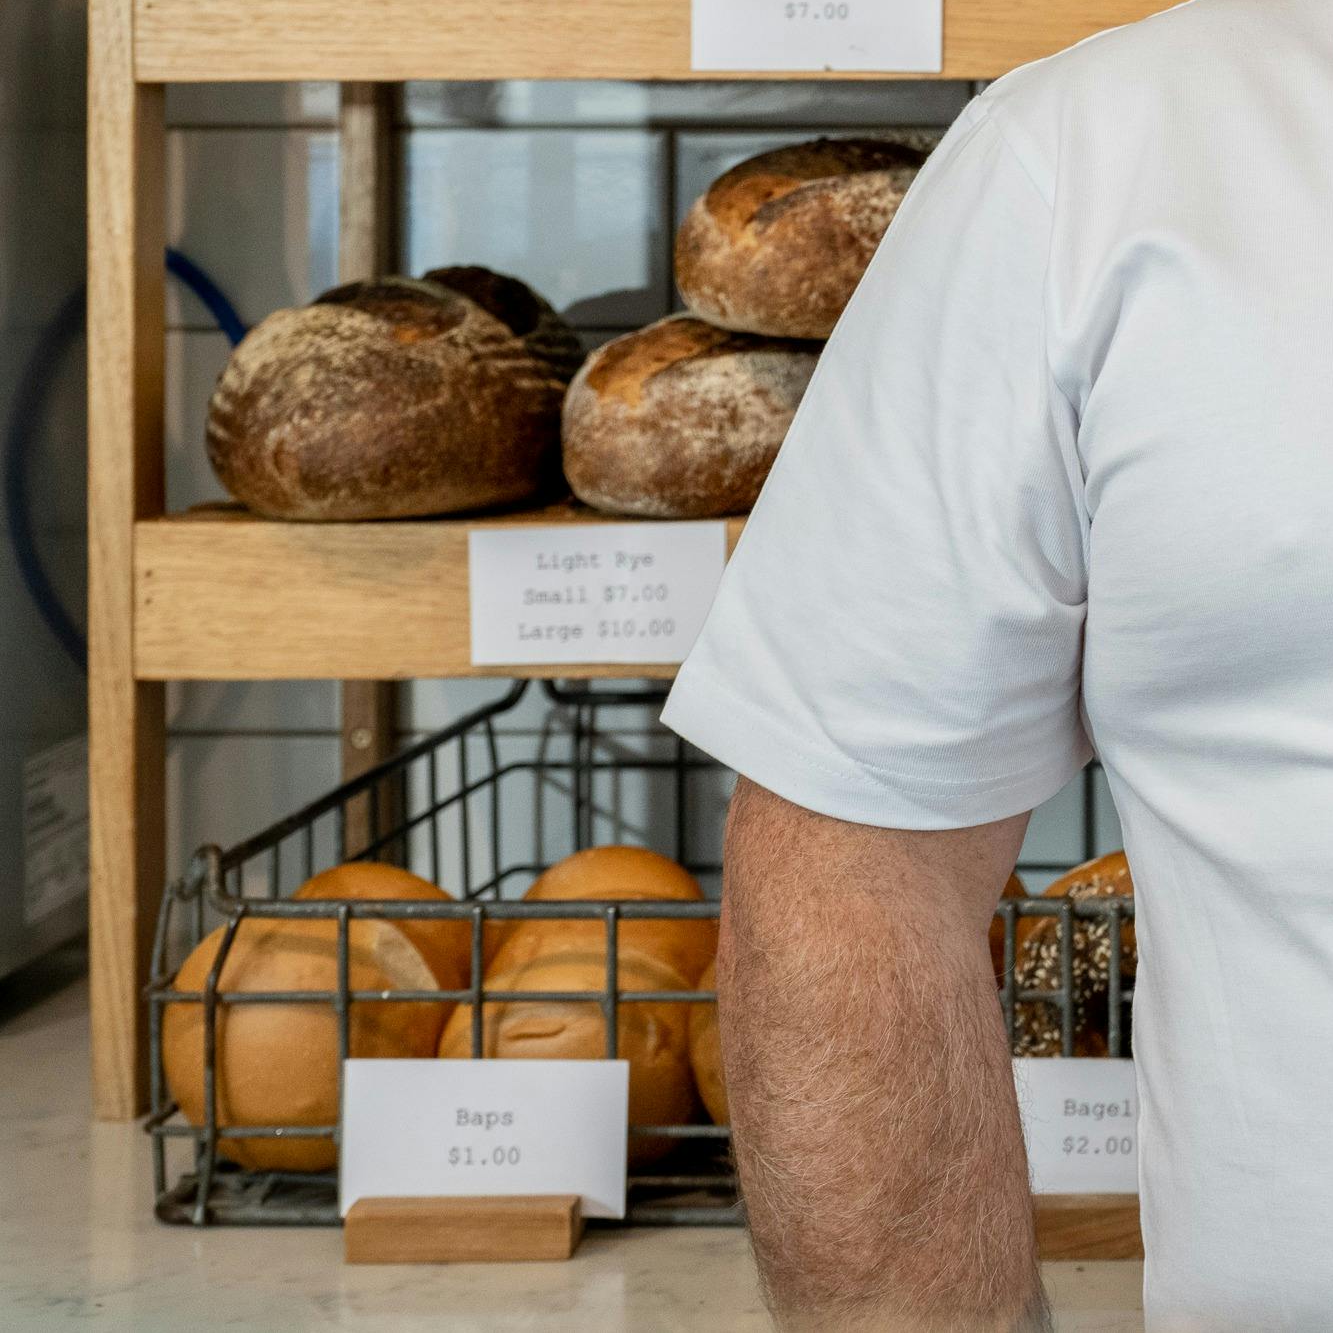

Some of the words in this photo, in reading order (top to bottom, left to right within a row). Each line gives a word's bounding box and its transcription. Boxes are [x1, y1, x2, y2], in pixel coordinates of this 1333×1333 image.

[785, 2, 850, 21] $7.00
[535, 552, 600, 574] Light
[615, 551, 654, 570] Rye
[522, 586, 588, 605] Small
[603, 585, 669, 603] $7.00
[517, 622, 584, 643] Large
[598, 618, 676, 639] $10.00
[456, 1108, 515, 1130] Baps
[1063, 1098, 1132, 1121] Bagel
[448, 1146, 521, 1166] $1.00
[1062, 1136, 1133, 1156] $2.00
